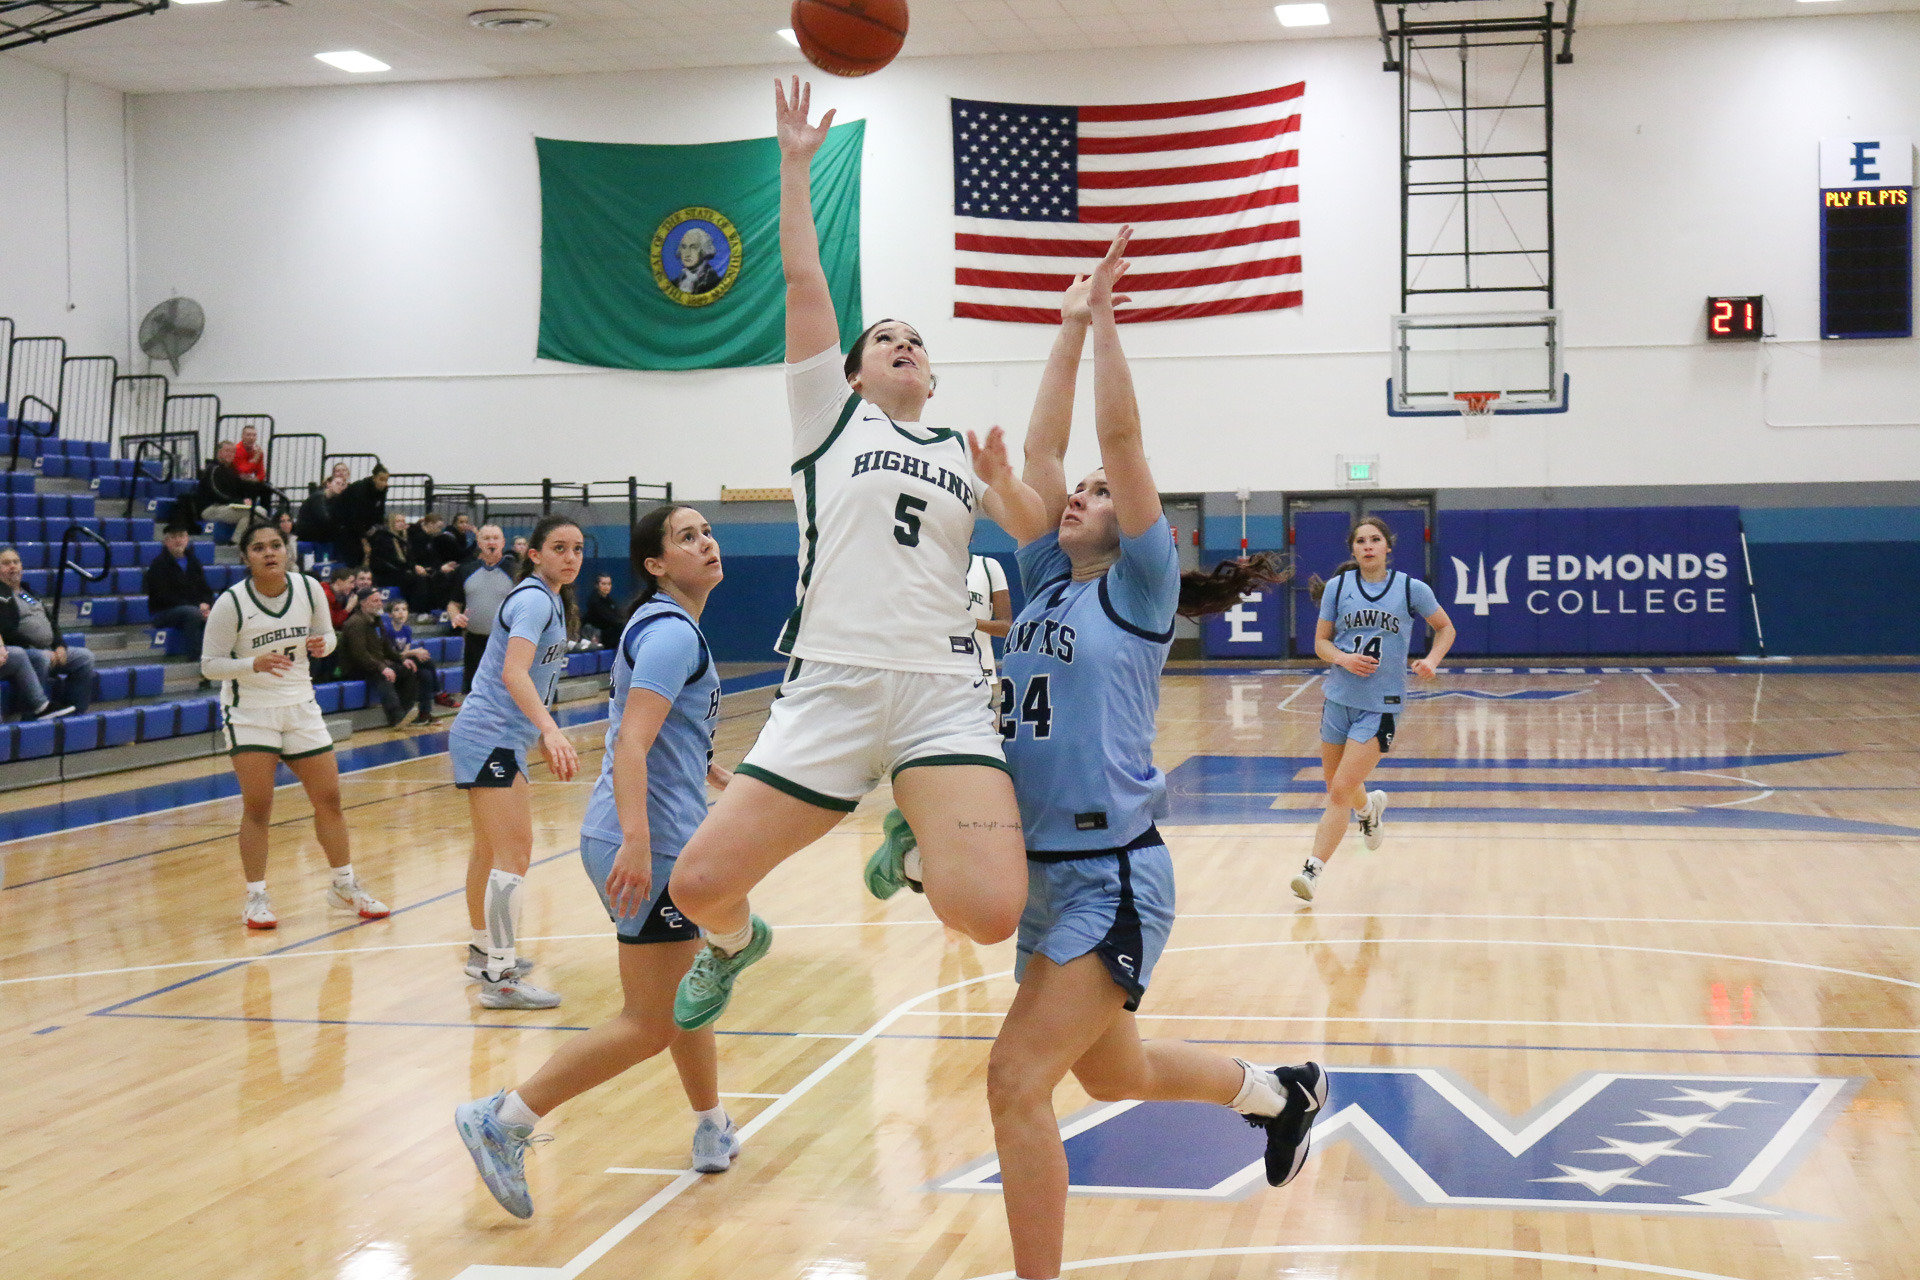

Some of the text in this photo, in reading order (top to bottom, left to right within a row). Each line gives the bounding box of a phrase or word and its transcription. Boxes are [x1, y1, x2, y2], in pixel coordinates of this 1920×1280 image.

[1825, 189, 1908, 207] PLY FL PTS
[685, 208, 713, 219] STATE
[1713, 301, 1753, 333] 21
[851, 450, 973, 513] HIGHLINE
[893, 492, 928, 547] 5
[1527, 553, 1728, 581] EDMONDS
[1527, 588, 1726, 615] COLLEGE
[1224, 592, 1263, 642] E
[1343, 609, 1400, 634] HAWKS
[252, 626, 307, 649] HIGHLINE
[1003, 619, 1076, 665] AWKS
[1352, 635, 1384, 667] 14
[271, 645, 297, 662] 5
[999, 673, 1054, 741] 24
